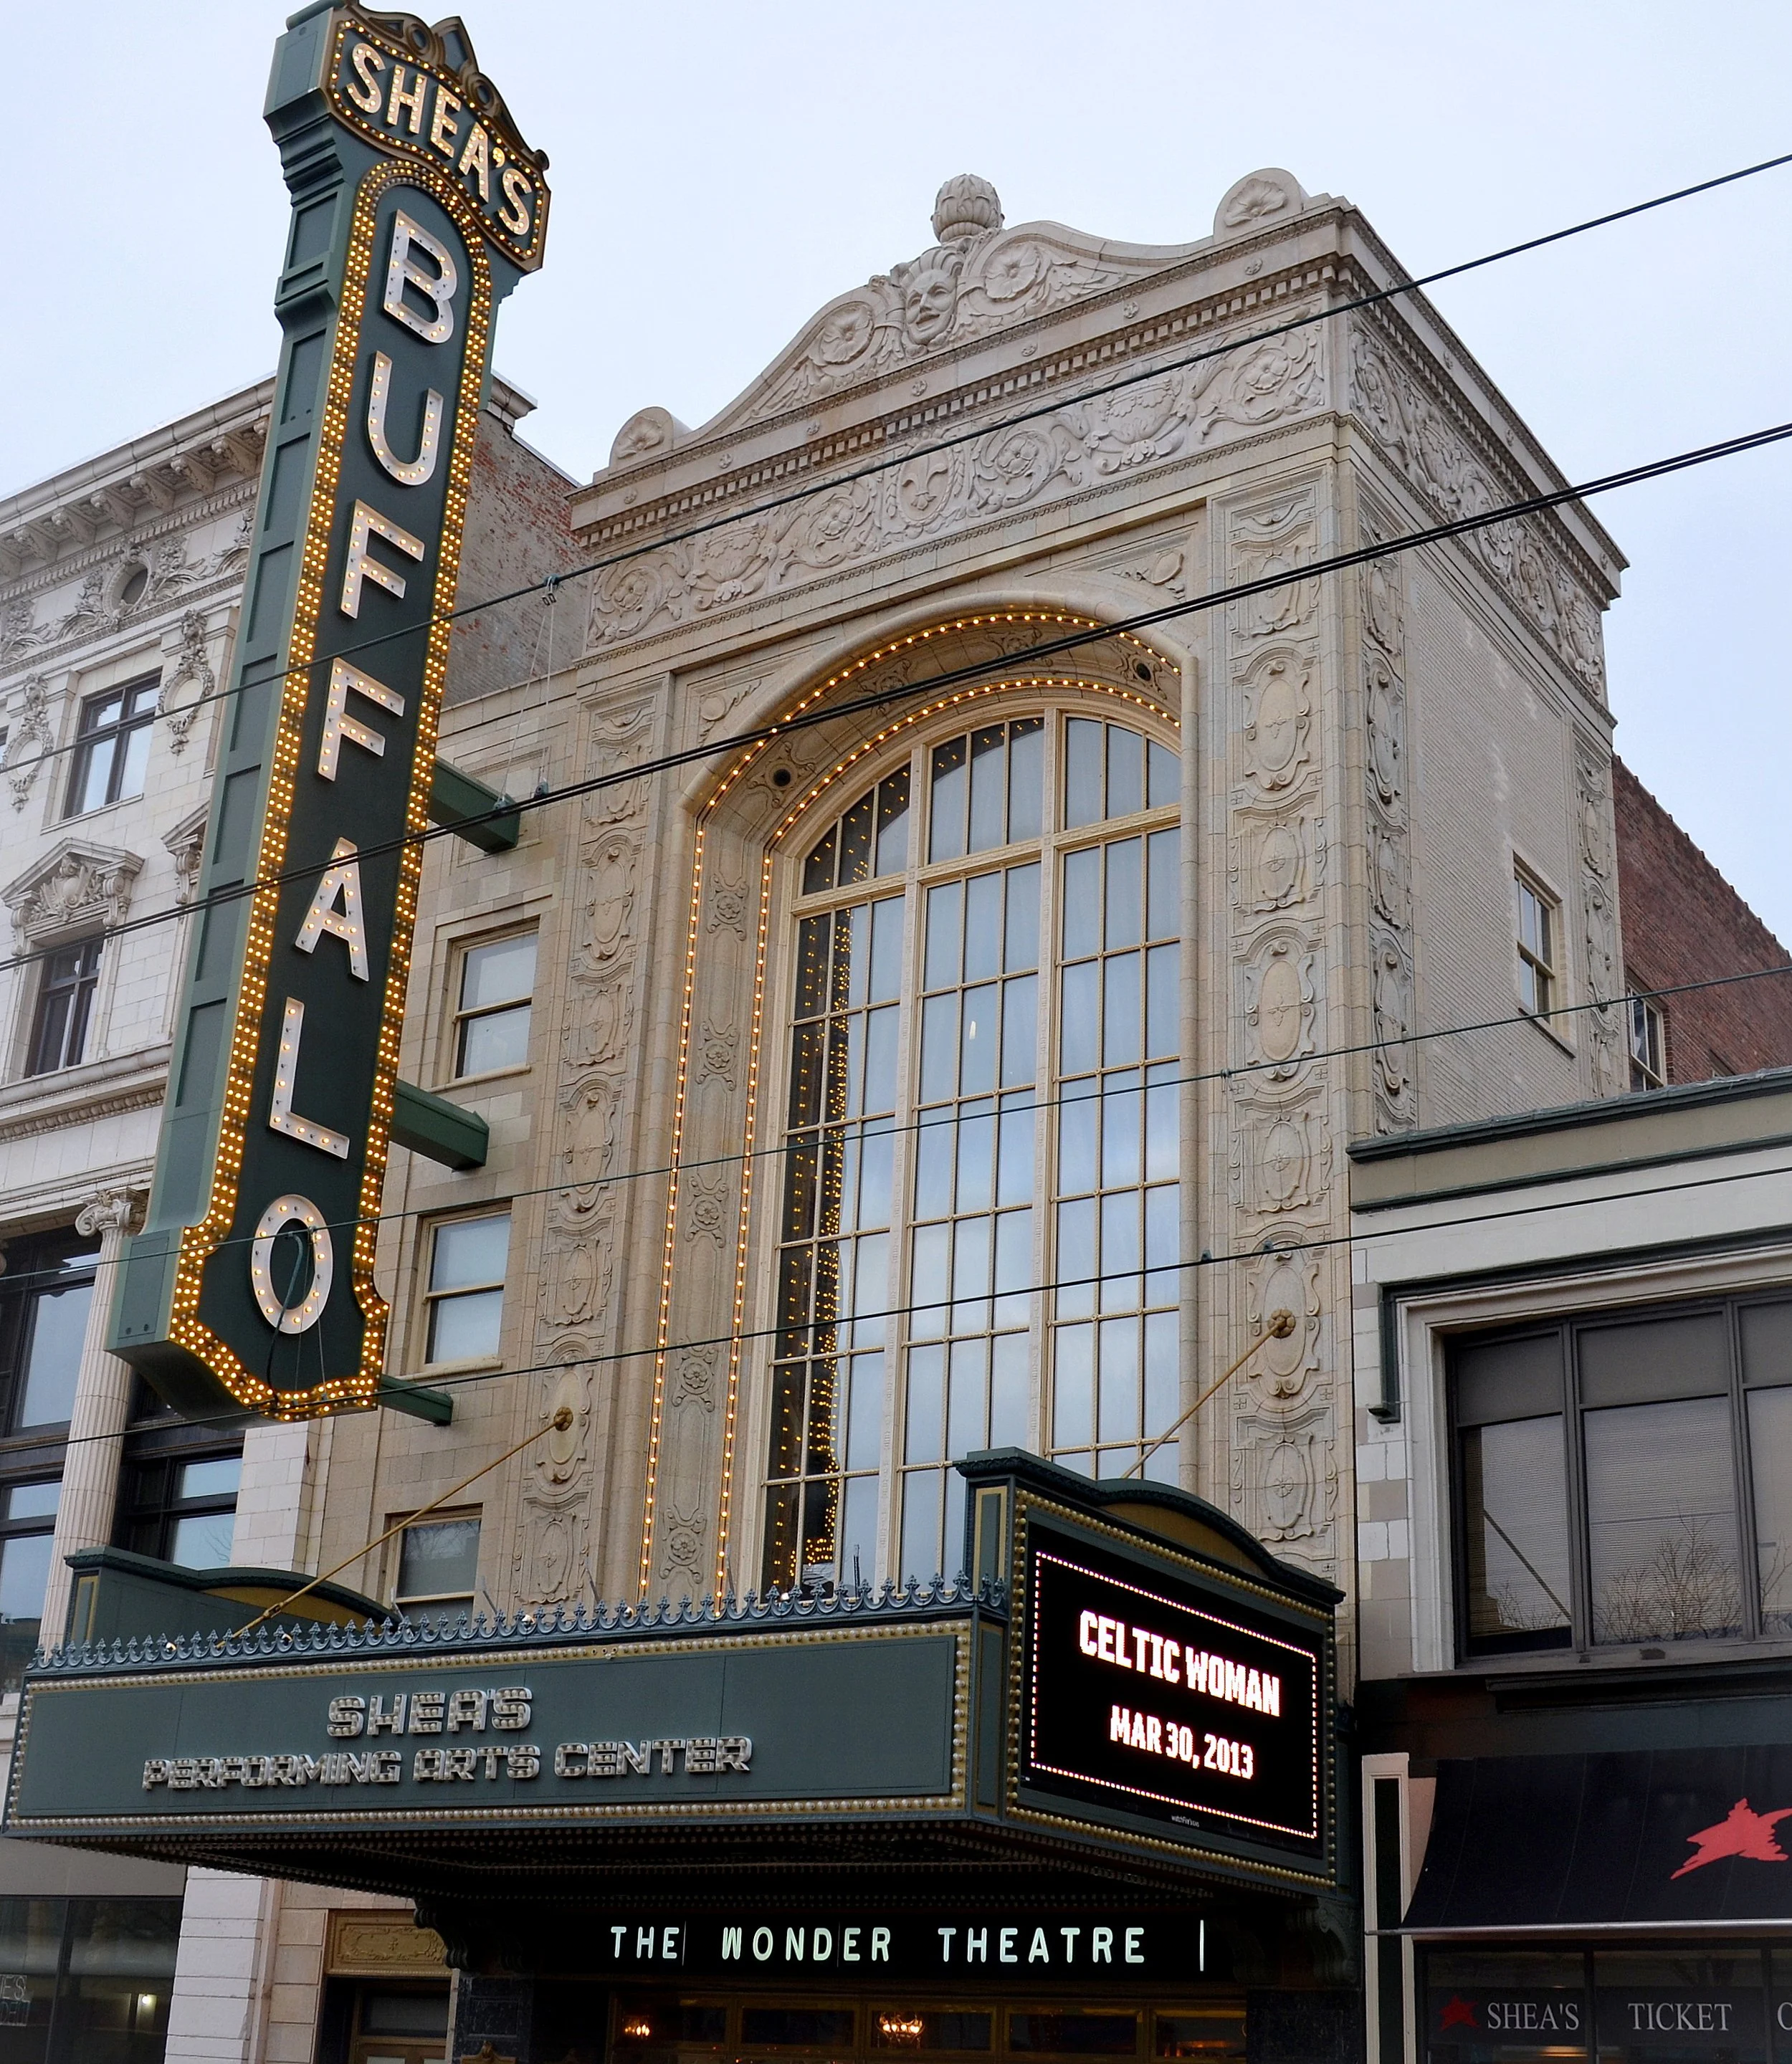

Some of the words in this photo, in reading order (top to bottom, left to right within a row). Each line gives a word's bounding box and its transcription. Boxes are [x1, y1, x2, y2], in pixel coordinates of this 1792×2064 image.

[346, 43, 532, 236] SHEA'S
[251, 209, 457, 1334] BUFFALO
[1079, 1610, 1181, 1683] CELTIC
[1185, 1645, 1280, 1717] WOMAN
[327, 1687, 533, 1737] SHEA'S
[1110, 1705, 1162, 1754] MAR
[1166, 1722, 1201, 1769] 30,
[1204, 1733, 1254, 1780] 2013
[142, 1749, 402, 1790] PERFORMING
[412, 1744, 541, 1782] ARTS
[554, 1736, 753, 1777] CENTER
[611, 1926, 680, 1959] THE
[722, 1926, 891, 1962] WONDER
[938, 1927, 1145, 1963] THEATRE
[1487, 2002, 1581, 2030] SHEA'S
[1627, 2002, 1733, 2032] TICKET
